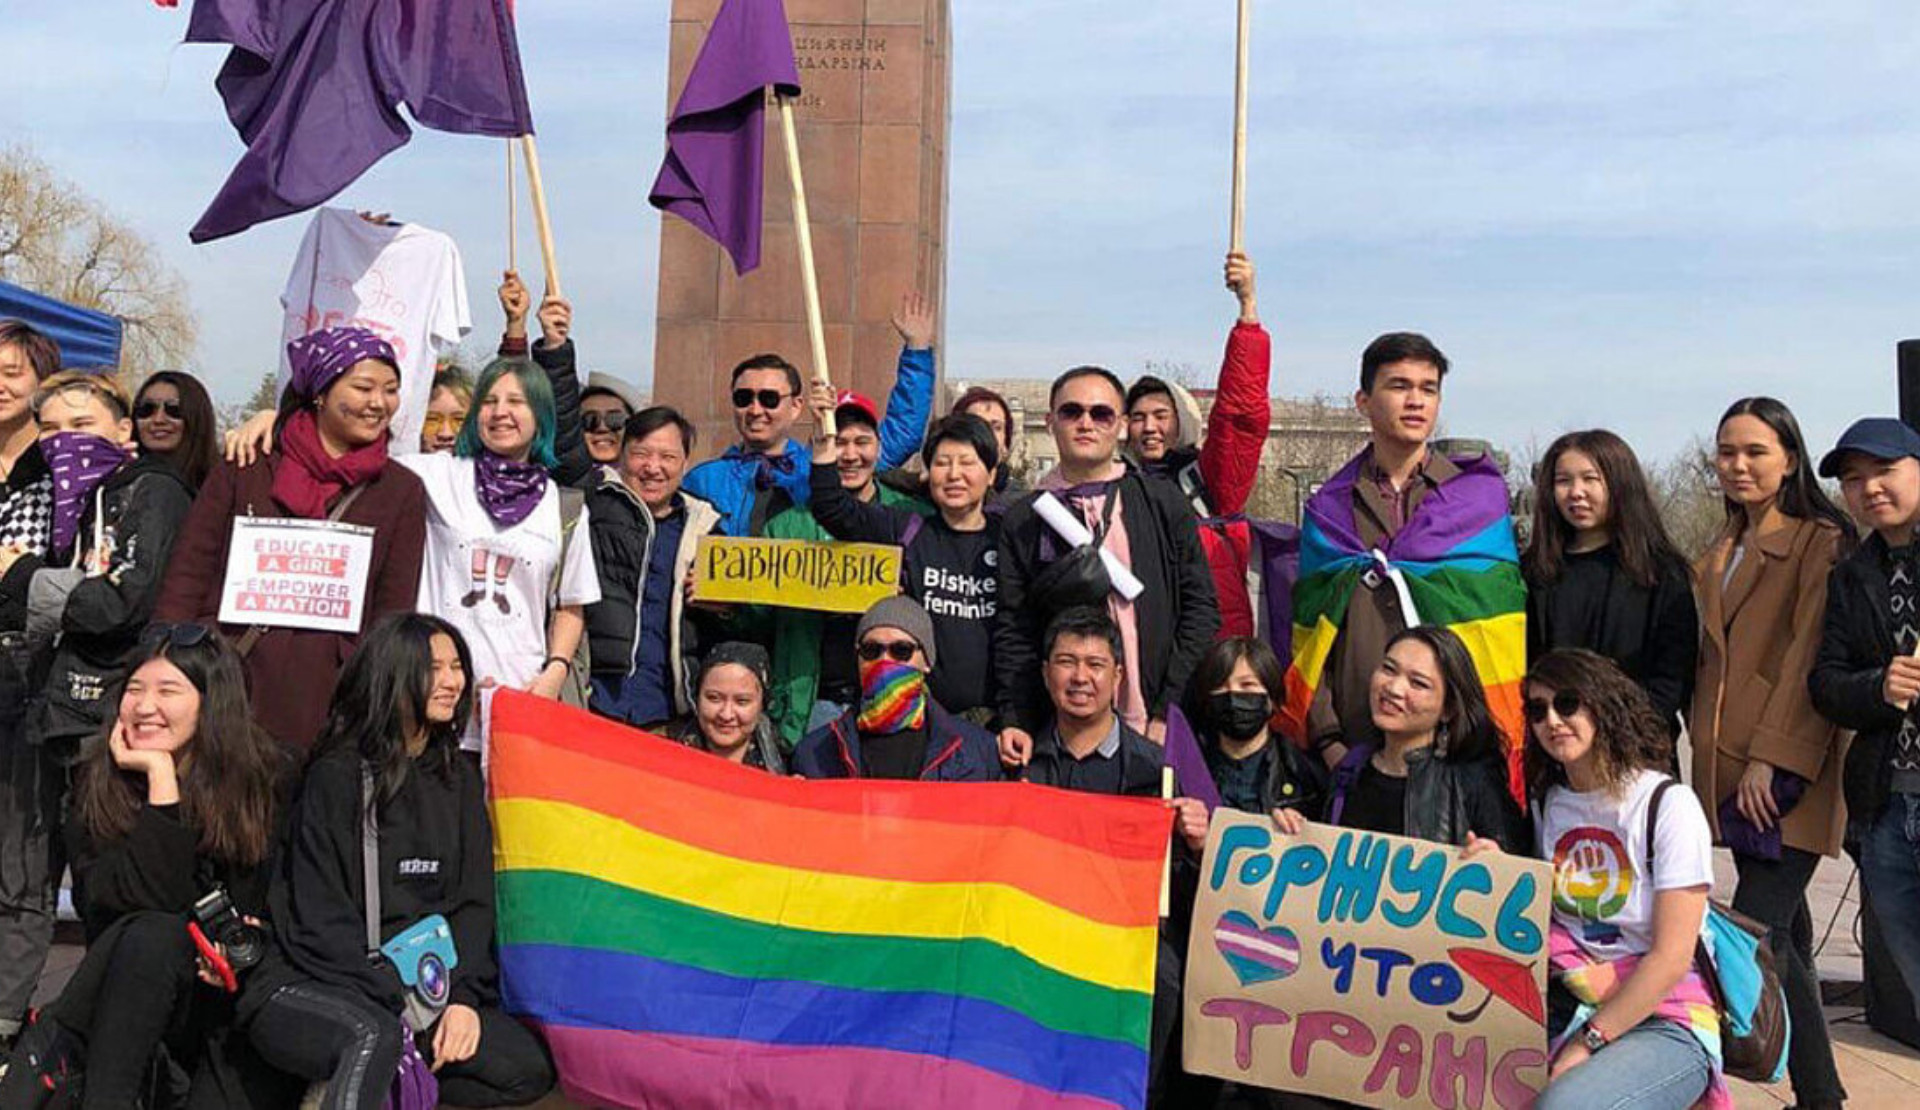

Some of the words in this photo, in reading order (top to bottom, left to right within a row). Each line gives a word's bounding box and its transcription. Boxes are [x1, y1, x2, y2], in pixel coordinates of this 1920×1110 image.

[253, 538, 351, 559] EDUCATE
[265, 557, 281, 571] A
[287, 557, 333, 575] GIRL
[246, 577, 350, 599] EMPOWER
[243, 593, 258, 610] A
[265, 594, 346, 616] NATION
[1320, 936, 1464, 1006] ЧТО
[1200, 997, 1547, 1110] ТРАНС
